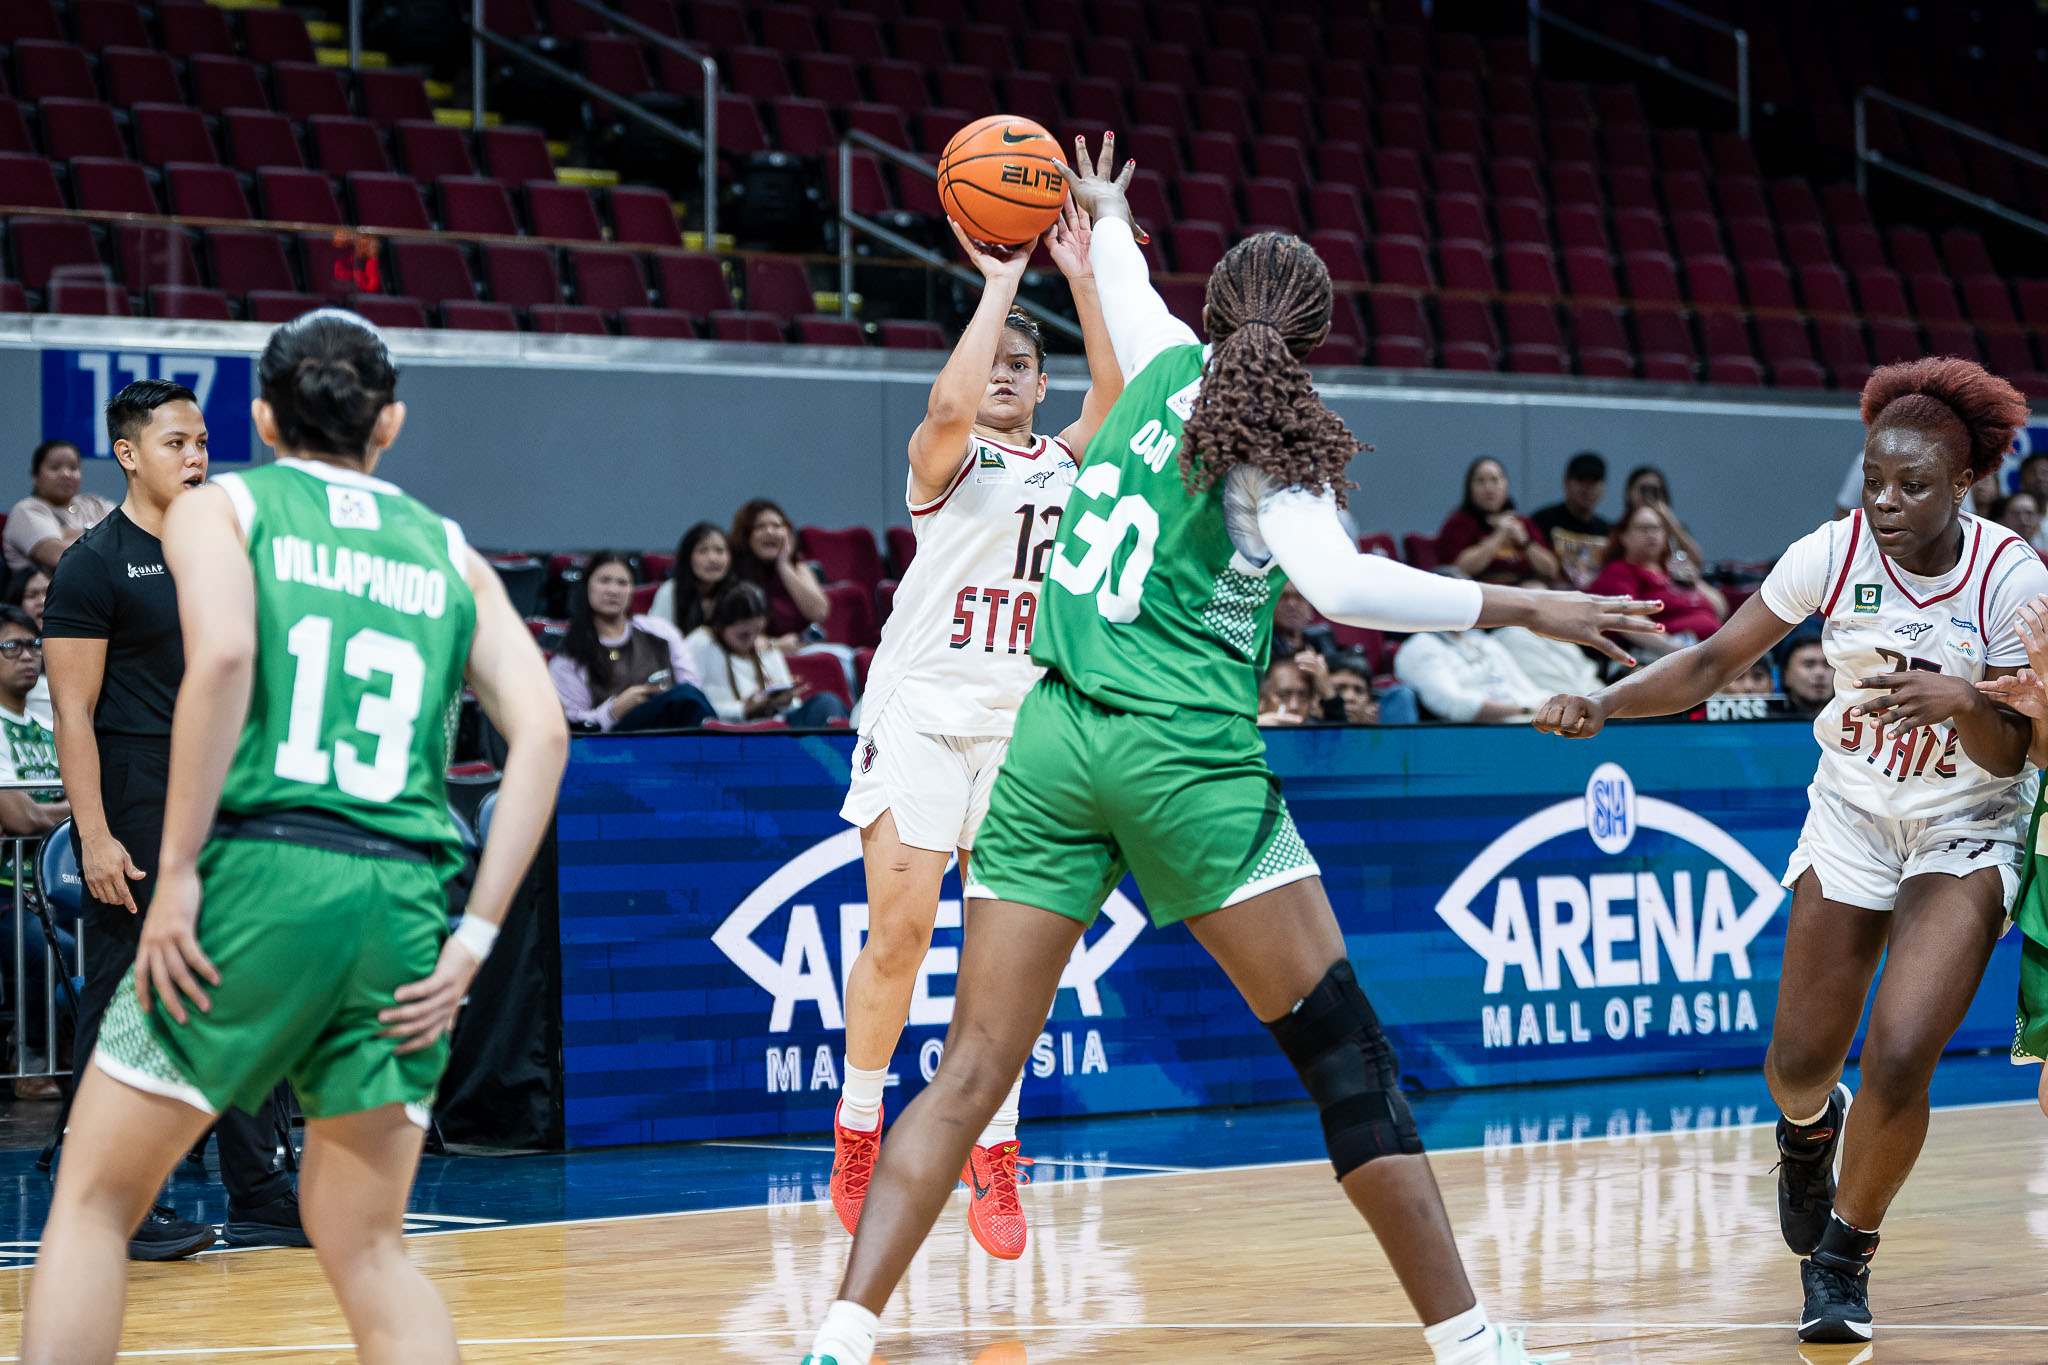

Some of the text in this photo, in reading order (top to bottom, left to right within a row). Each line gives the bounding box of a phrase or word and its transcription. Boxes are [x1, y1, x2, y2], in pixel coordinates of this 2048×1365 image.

[1002, 163, 1062, 192] ELITE
[1130, 419, 1177, 474] OJO
[272, 534, 447, 620] VILLAPANDO
[1013, 504, 1064, 582] 12
[949, 586, 1038, 655] STA
[274, 614, 426, 804] 13
[1841, 706, 1958, 782] STATE
[1593, 780, 1627, 838] SM
[1483, 869, 1753, 994] ARENA
[1482, 989, 1759, 1048] MALL OF ASIA
[766, 1029, 1109, 1093] MA O SIA
